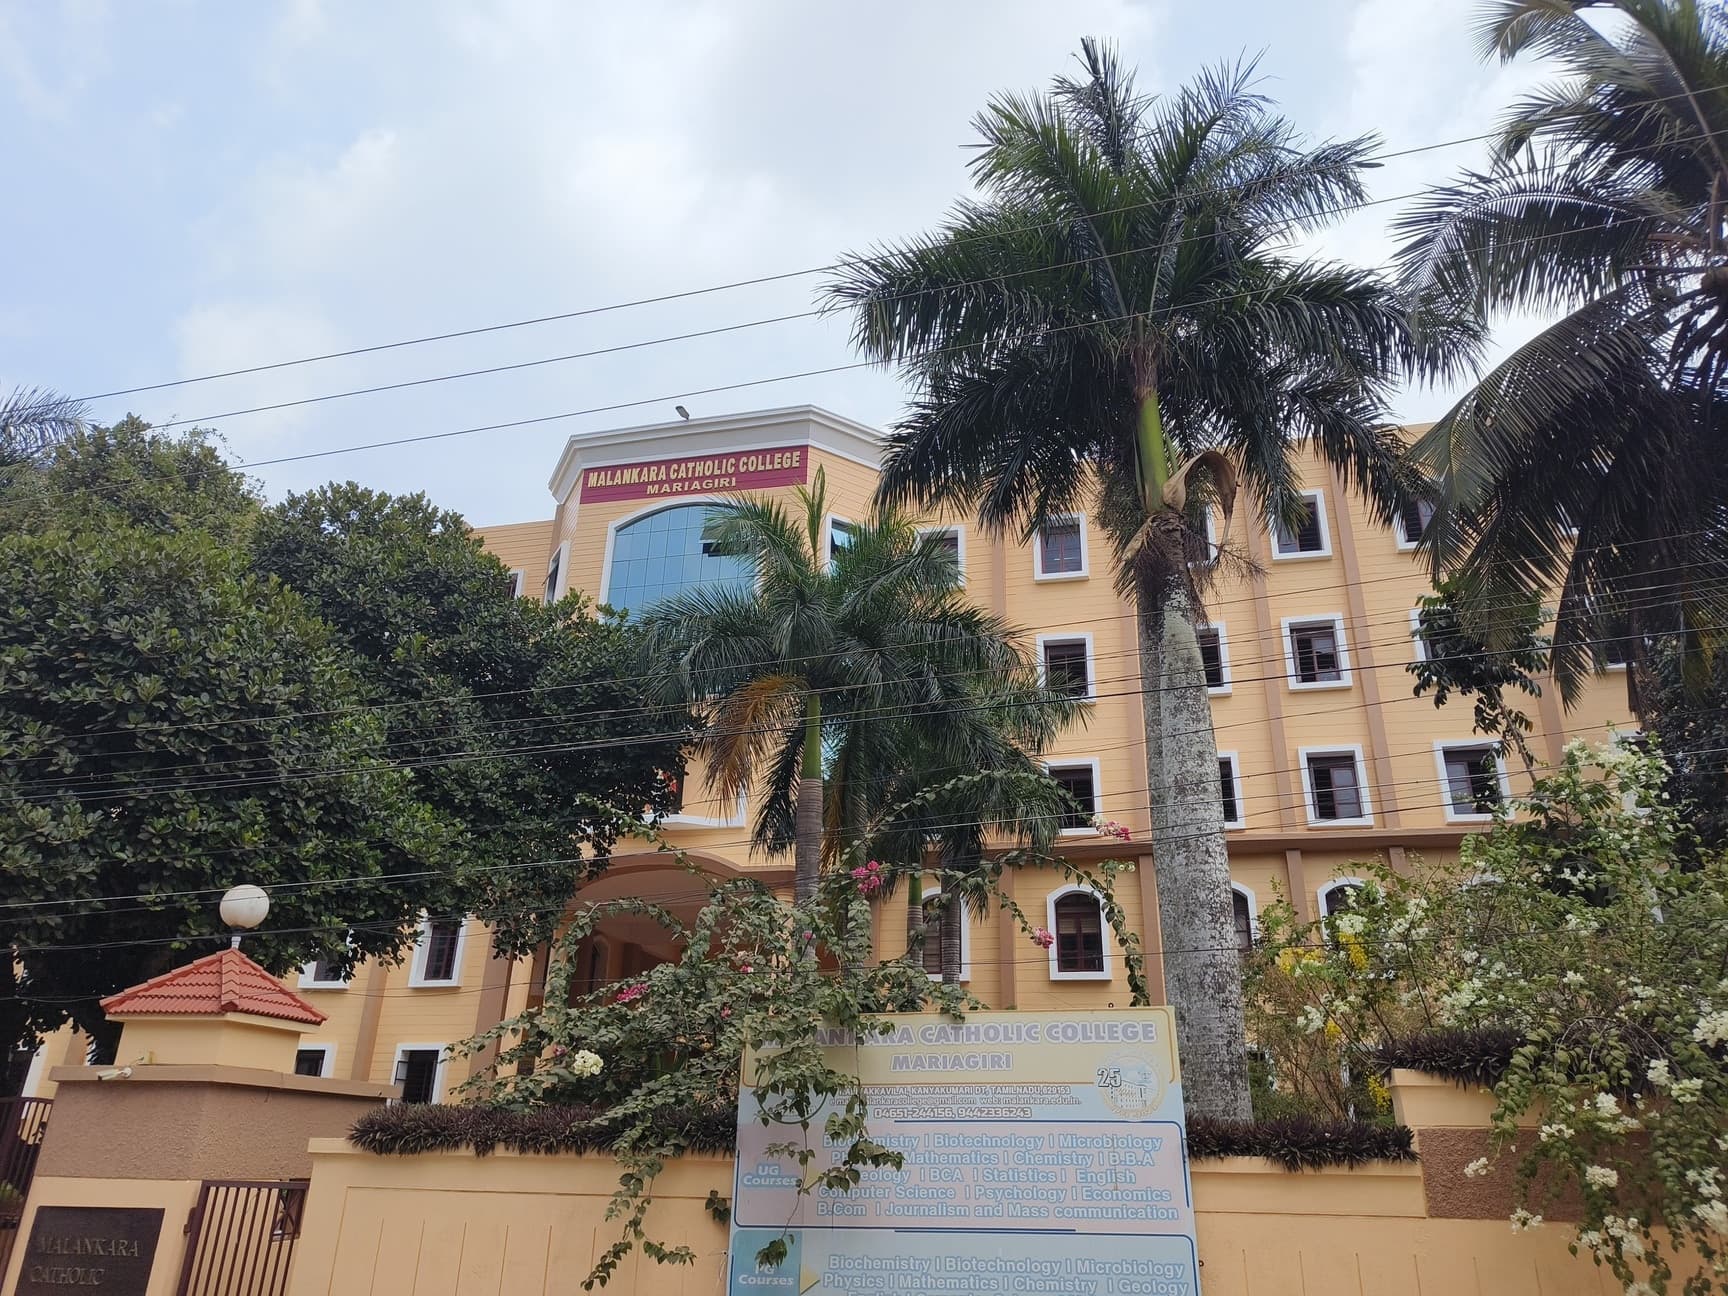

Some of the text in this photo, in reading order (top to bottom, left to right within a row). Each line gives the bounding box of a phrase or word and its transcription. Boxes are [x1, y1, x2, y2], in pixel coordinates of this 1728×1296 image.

[588, 451, 801, 488] MALANKARA CATHOLIC COLLEGE
[646, 477, 736, 495] MARIAGIRI
[919, 1023, 1040, 1045] CATHOLIC
[1045, 1022, 1157, 1043] COLLEGE
[890, 1053, 1013, 1072] MARIAGIRI
[1097, 1067, 1122, 1088] 25
[911, 1086, 973, 1096] KANYAKUMARI
[958, 1107, 1032, 1118] 9442336243
[934, 1134, 1044, 1151] Biotechnology
[1058, 1134, 1162, 1151] Microbiology
[903, 1151, 1154, 1168] Mathematics Chemistry B.B.A
[758, 1165, 779, 1176] UG
[860, 1168, 1136, 1186] eology BCA Statistics English
[743, 1175, 797, 1186] Courses
[895, 1185, 956, 1198] Science
[974, 1186, 1067, 1203] Psychology
[1082, 1187, 1172, 1201] Economics
[817, 1202, 1179, 1220] B.Com Journalism and Mass communication
[31, 1266, 105, 1285] CATHOLIC
[829, 1256, 1184, 1279] Biochemistry Biotechnology Microbiology
[738, 1274, 794, 1286] Courses
[823, 1273, 1188, 1296] Physics Mathematics Chemistry Geology
